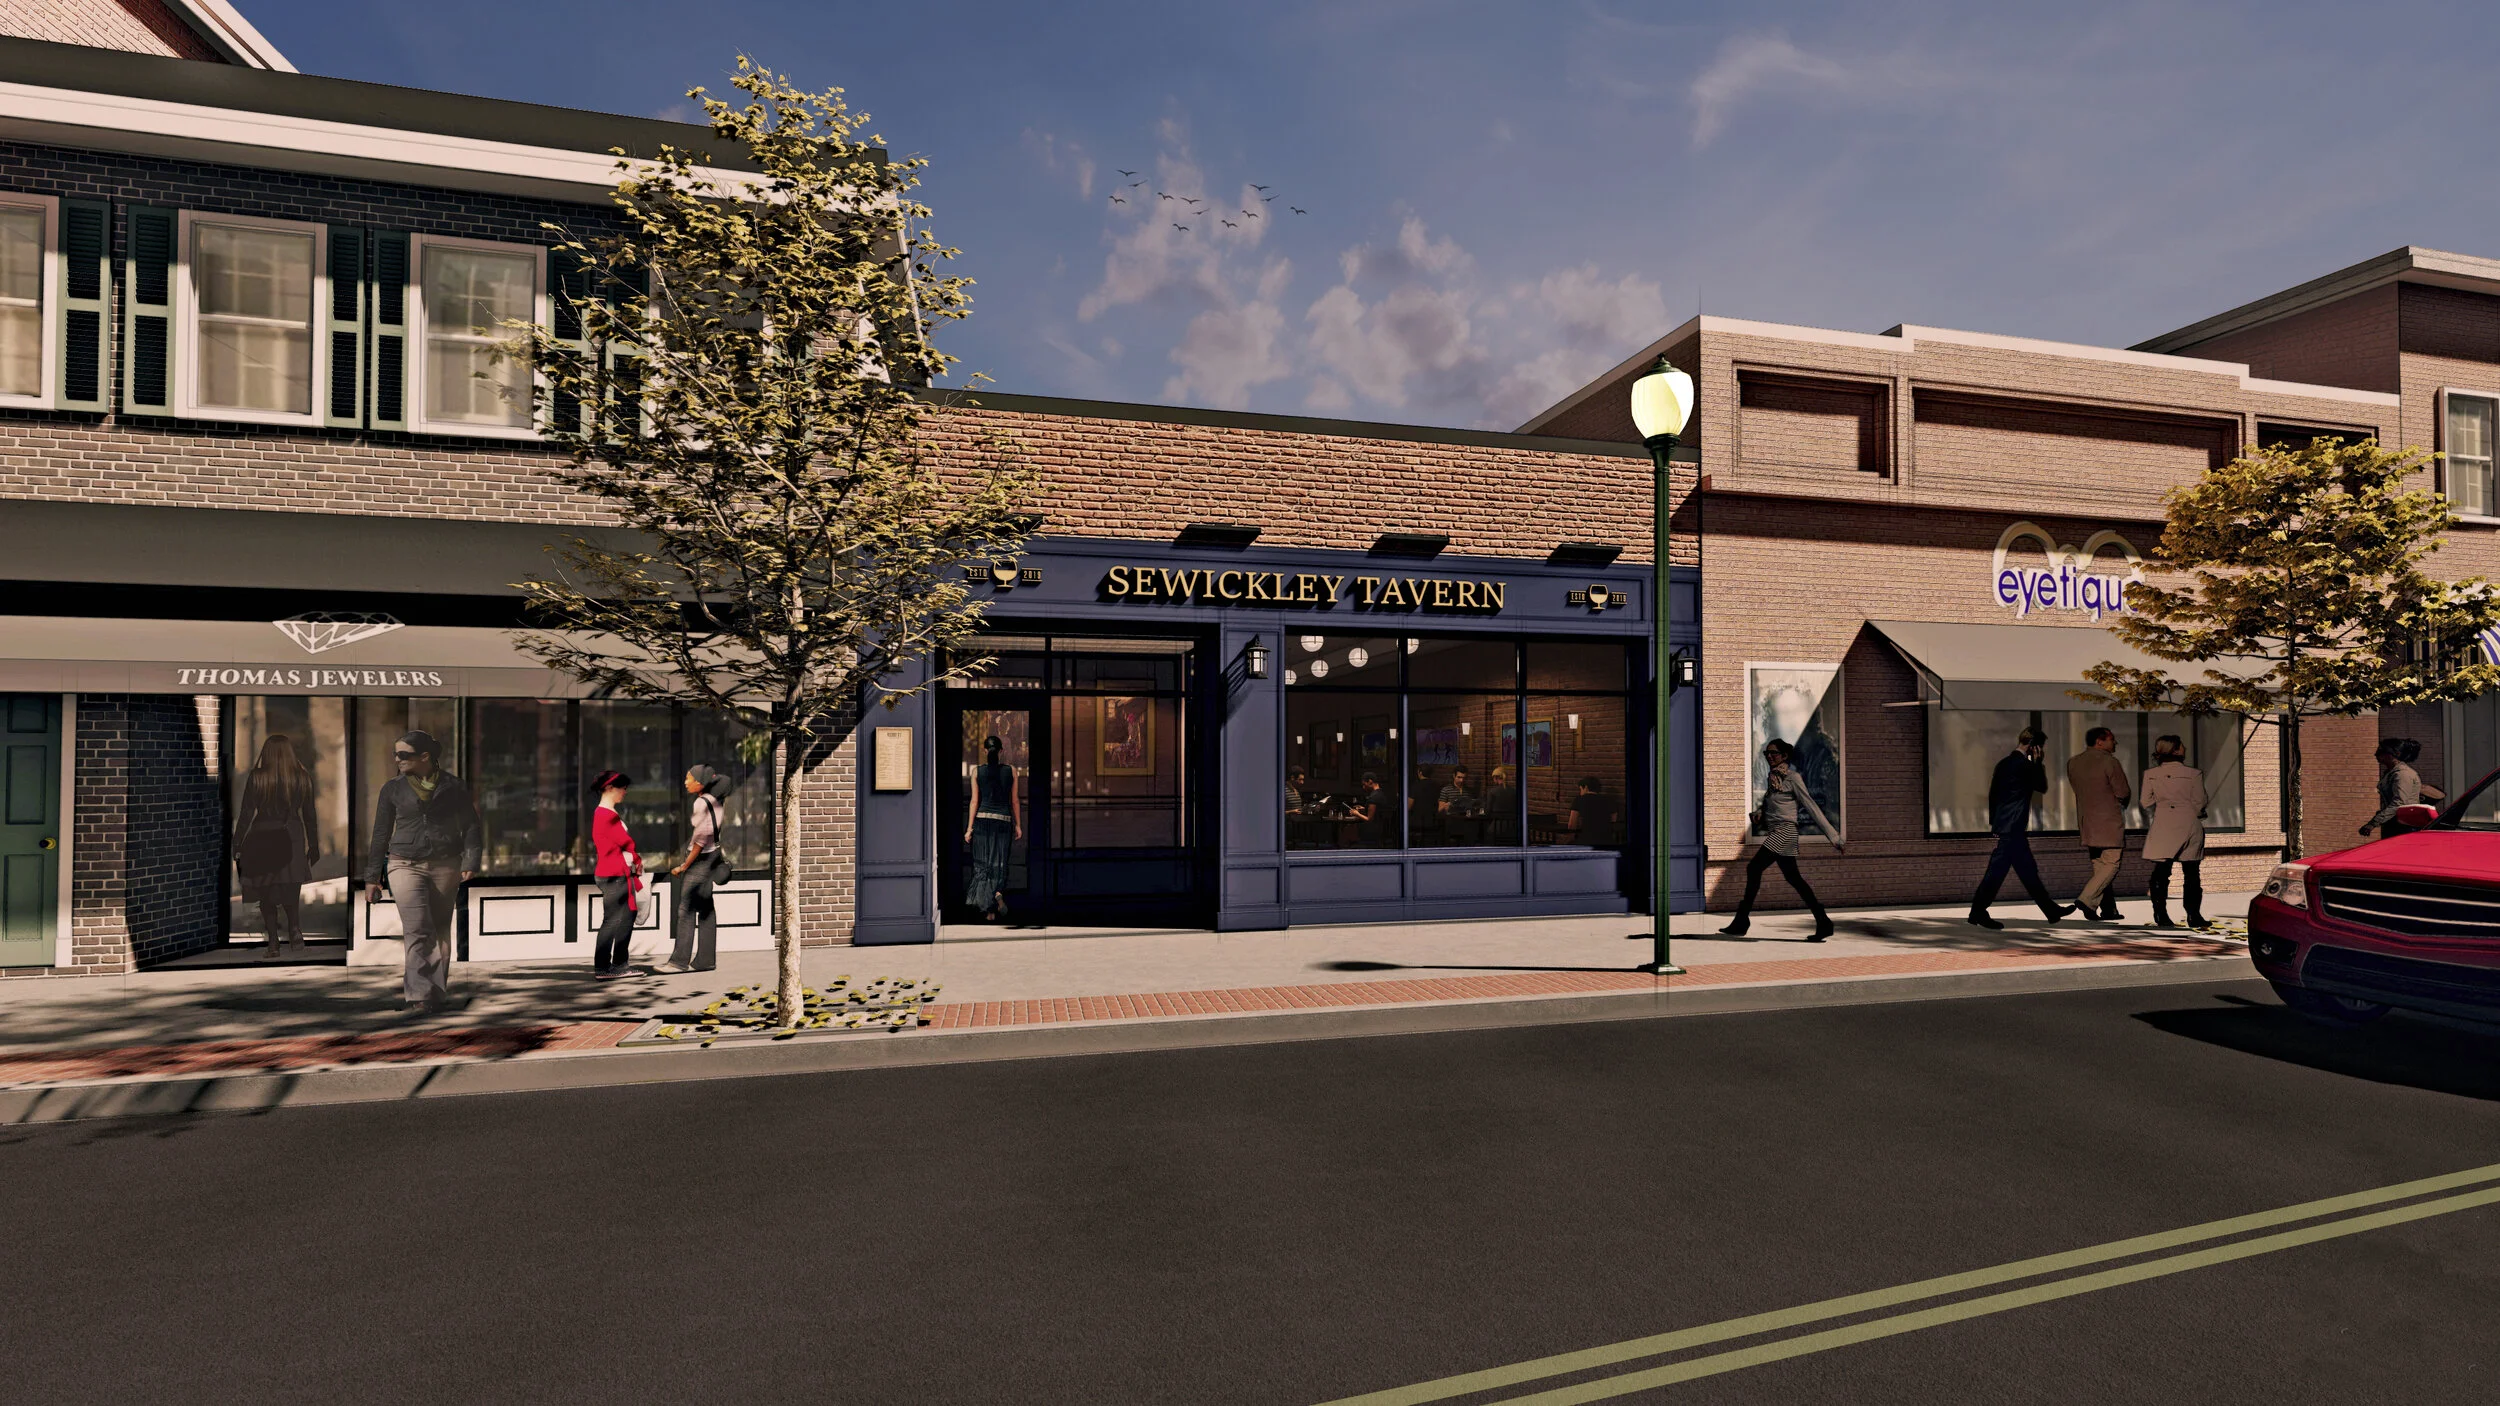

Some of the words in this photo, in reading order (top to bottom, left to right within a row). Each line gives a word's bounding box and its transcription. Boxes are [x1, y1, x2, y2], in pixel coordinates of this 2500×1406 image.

[1108, 565, 1344, 602] SEWICKLEY
[1357, 575, 1507, 609] TAVERN
[177, 667, 300, 686] THOMAS
[306, 670, 443, 688] JEWELERS
